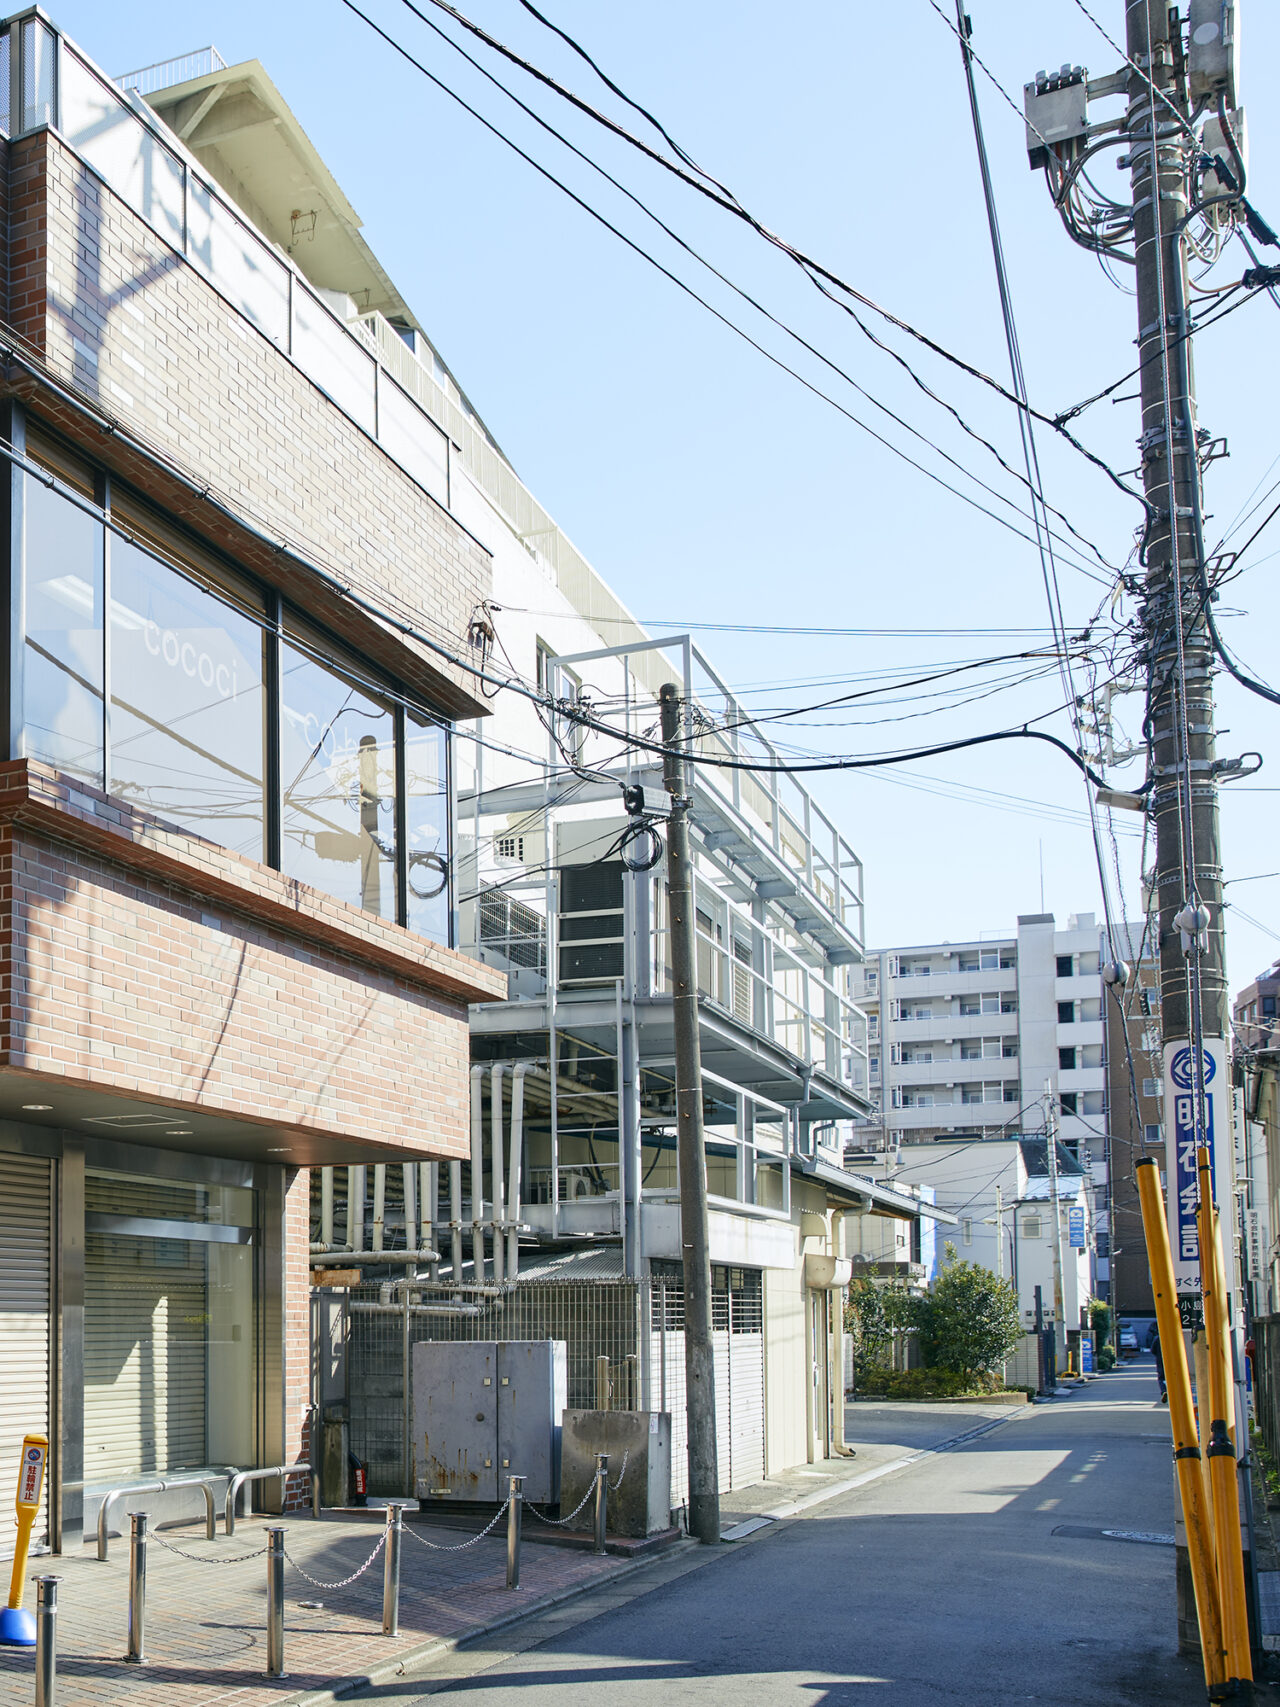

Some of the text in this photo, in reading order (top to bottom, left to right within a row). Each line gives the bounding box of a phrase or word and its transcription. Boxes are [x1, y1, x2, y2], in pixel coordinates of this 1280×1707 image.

[144, 620, 237, 701] cococi
[24, 1465, 37, 1501] 駐輪禁止
